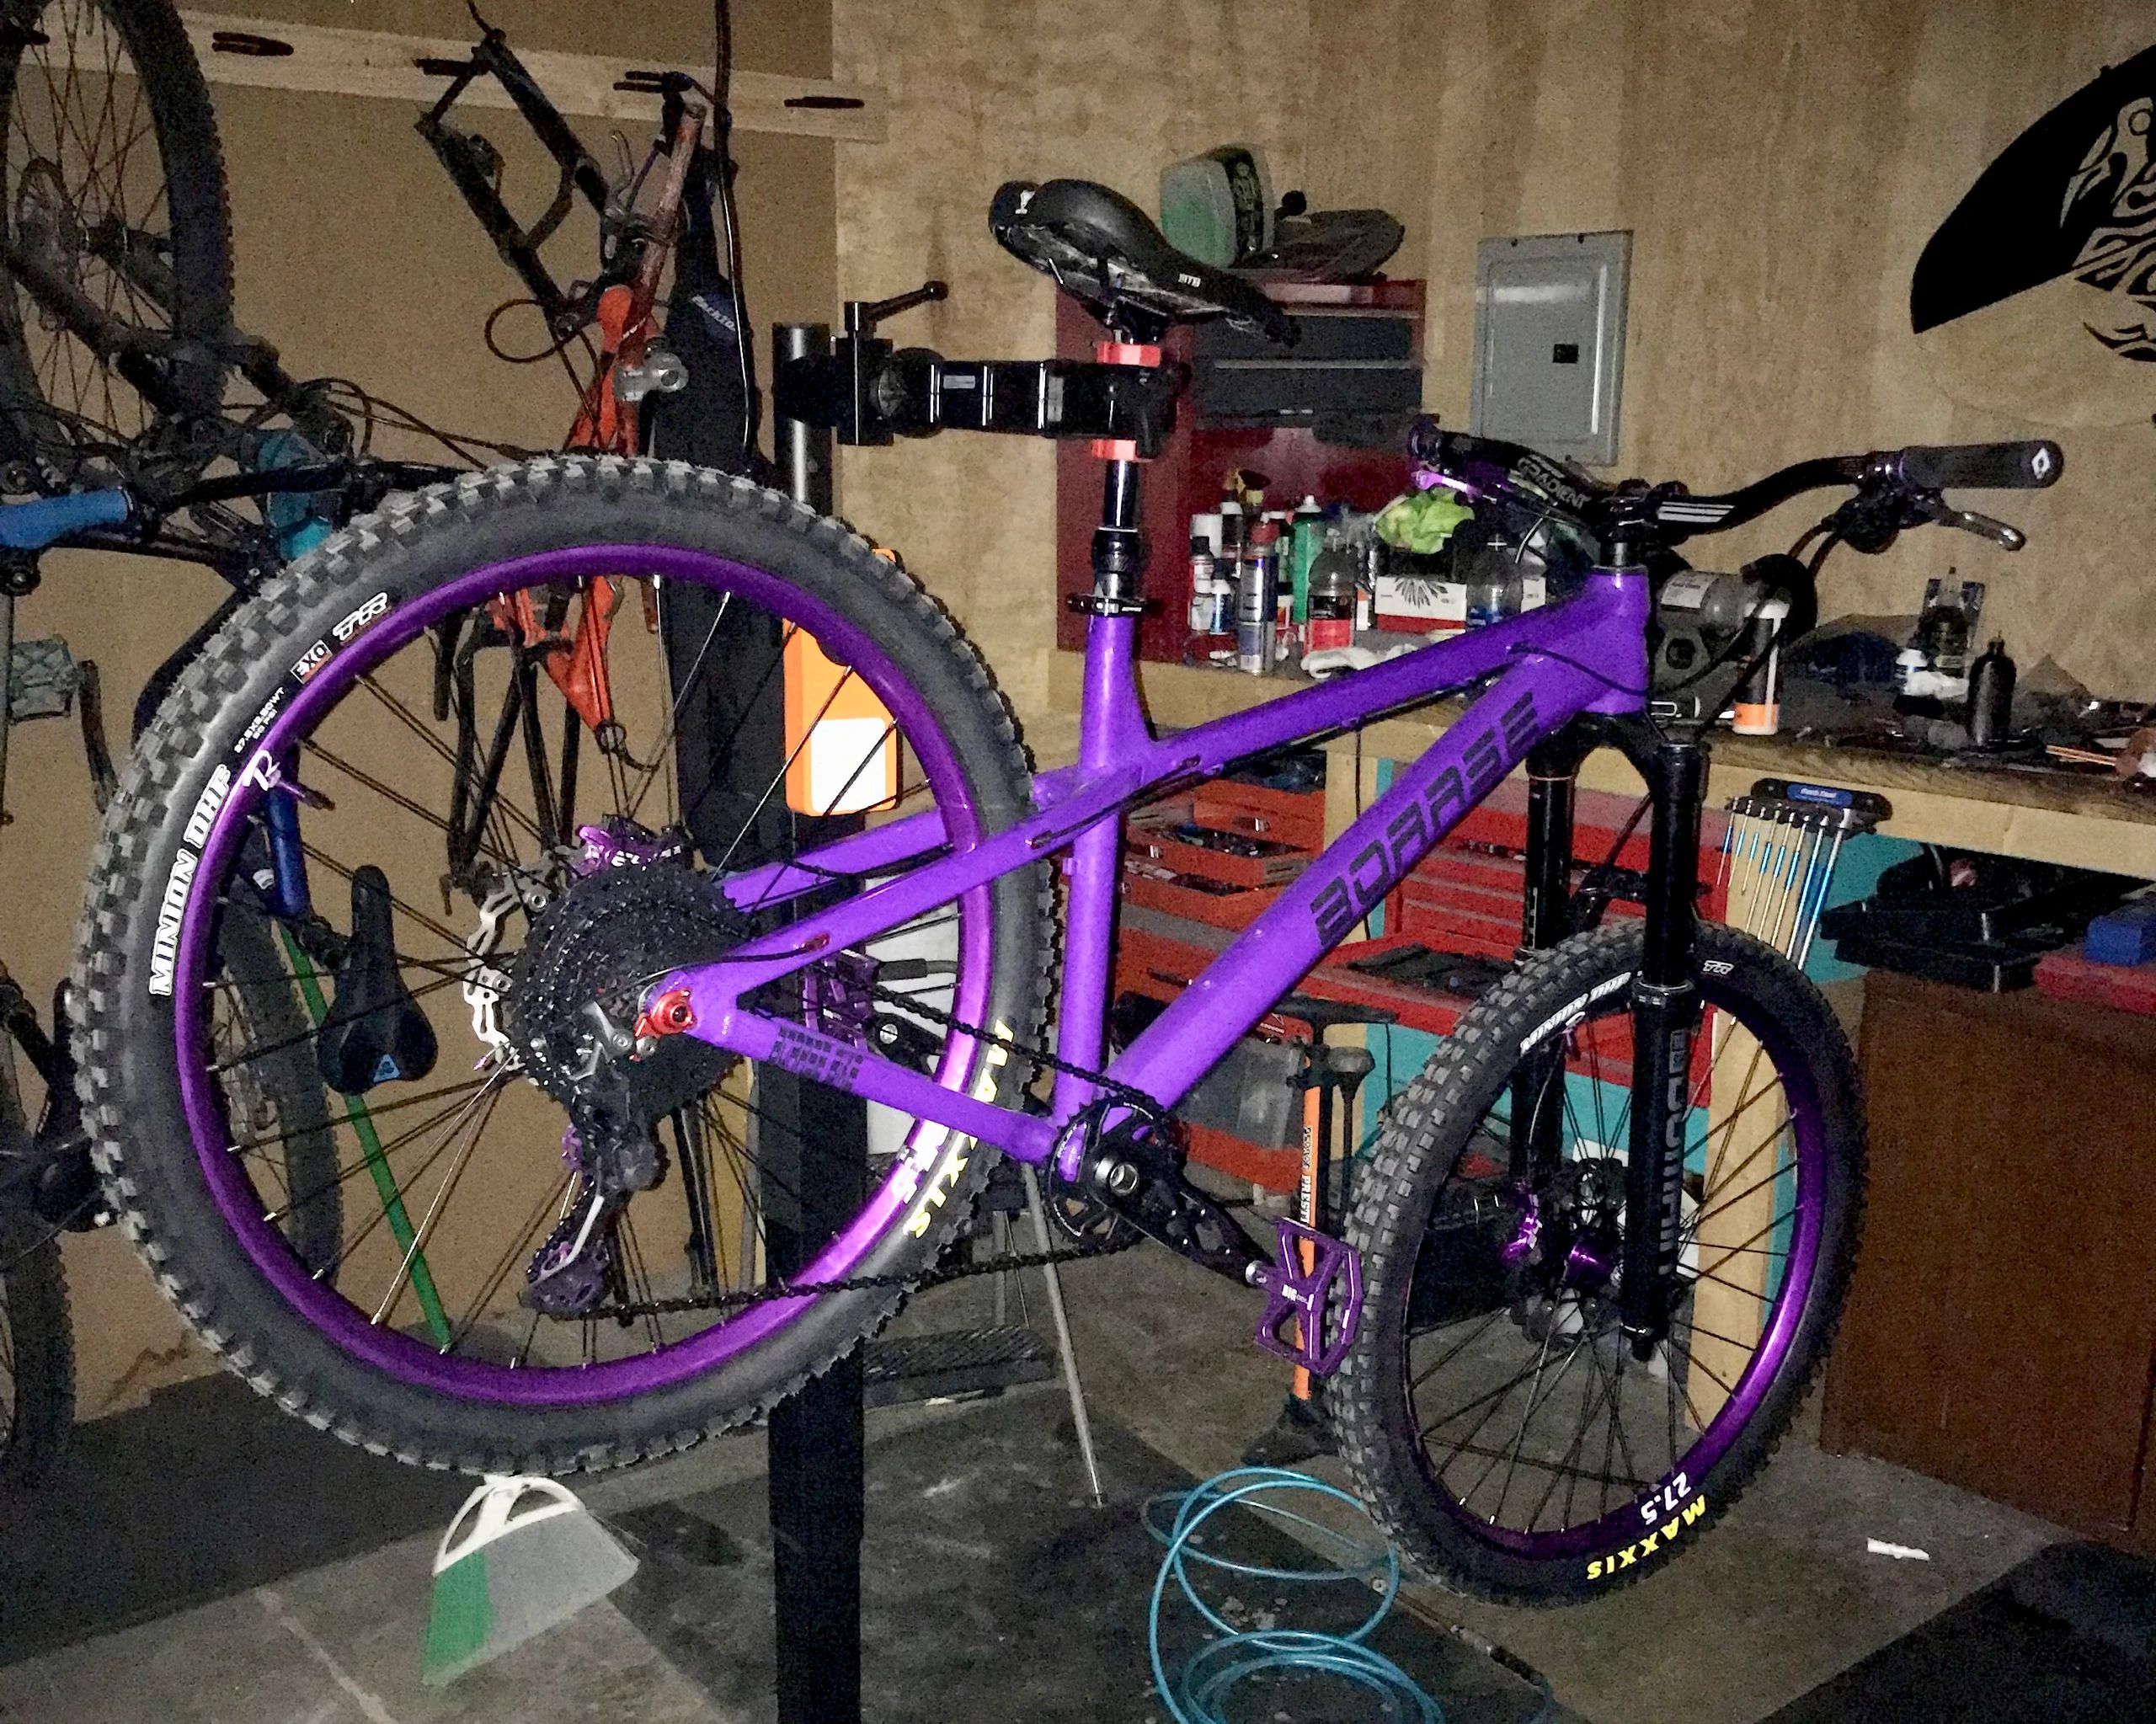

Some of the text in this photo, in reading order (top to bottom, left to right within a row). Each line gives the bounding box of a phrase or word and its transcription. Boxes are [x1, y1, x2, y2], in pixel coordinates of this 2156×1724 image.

[291, 641, 329, 679] EXO
[149, 764, 231, 996] MINION DHF
[1641, 1472, 1691, 1525] 27.5
[1587, 1494, 1706, 1580] MAXXIS
